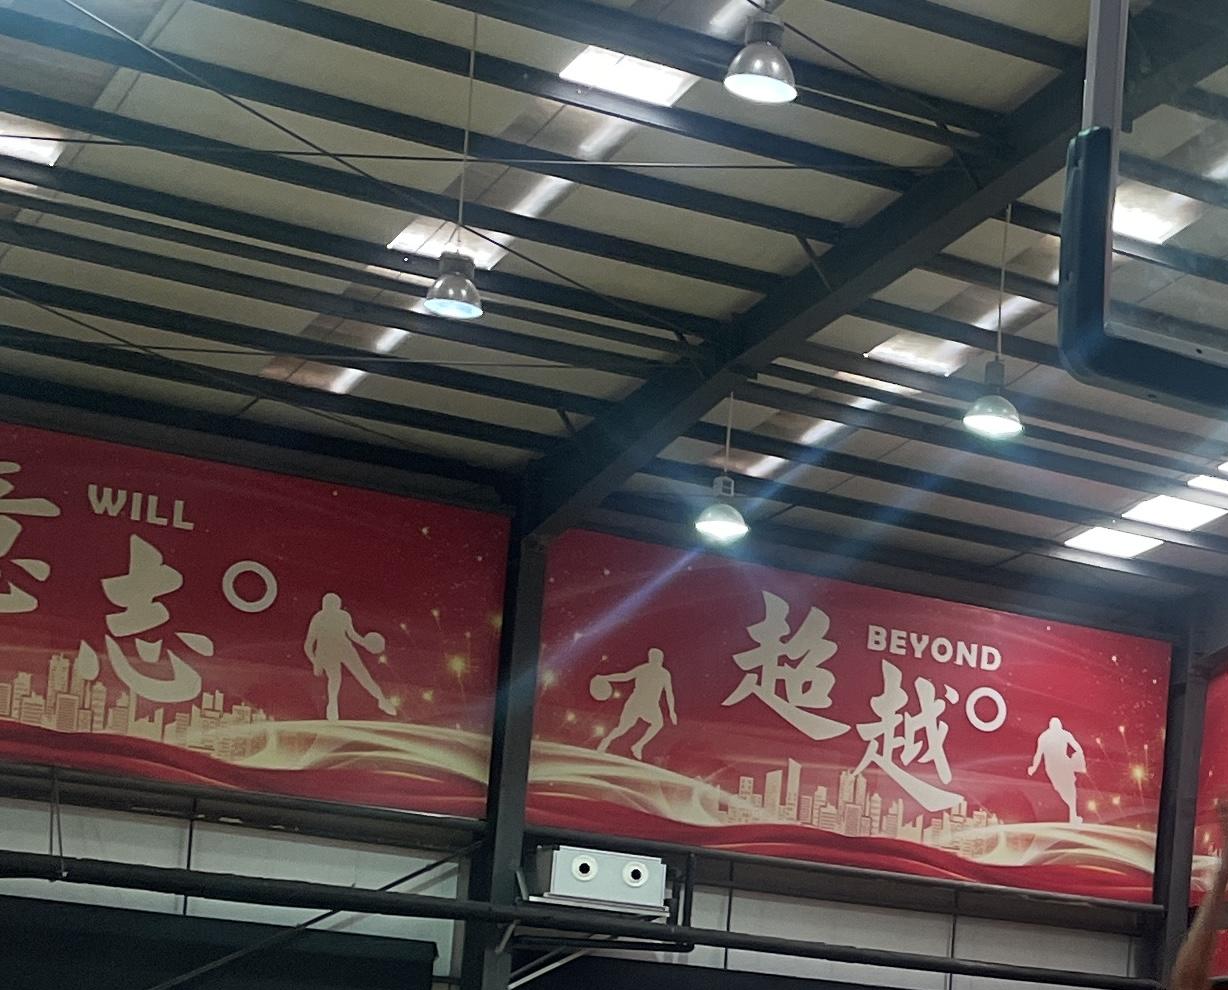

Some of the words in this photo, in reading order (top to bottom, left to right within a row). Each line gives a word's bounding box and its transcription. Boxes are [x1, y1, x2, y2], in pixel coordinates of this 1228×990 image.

[88, 484, 194, 530] WILL
[866, 624, 1003, 672] BEYOND
[721, 591, 965, 812] 超越
